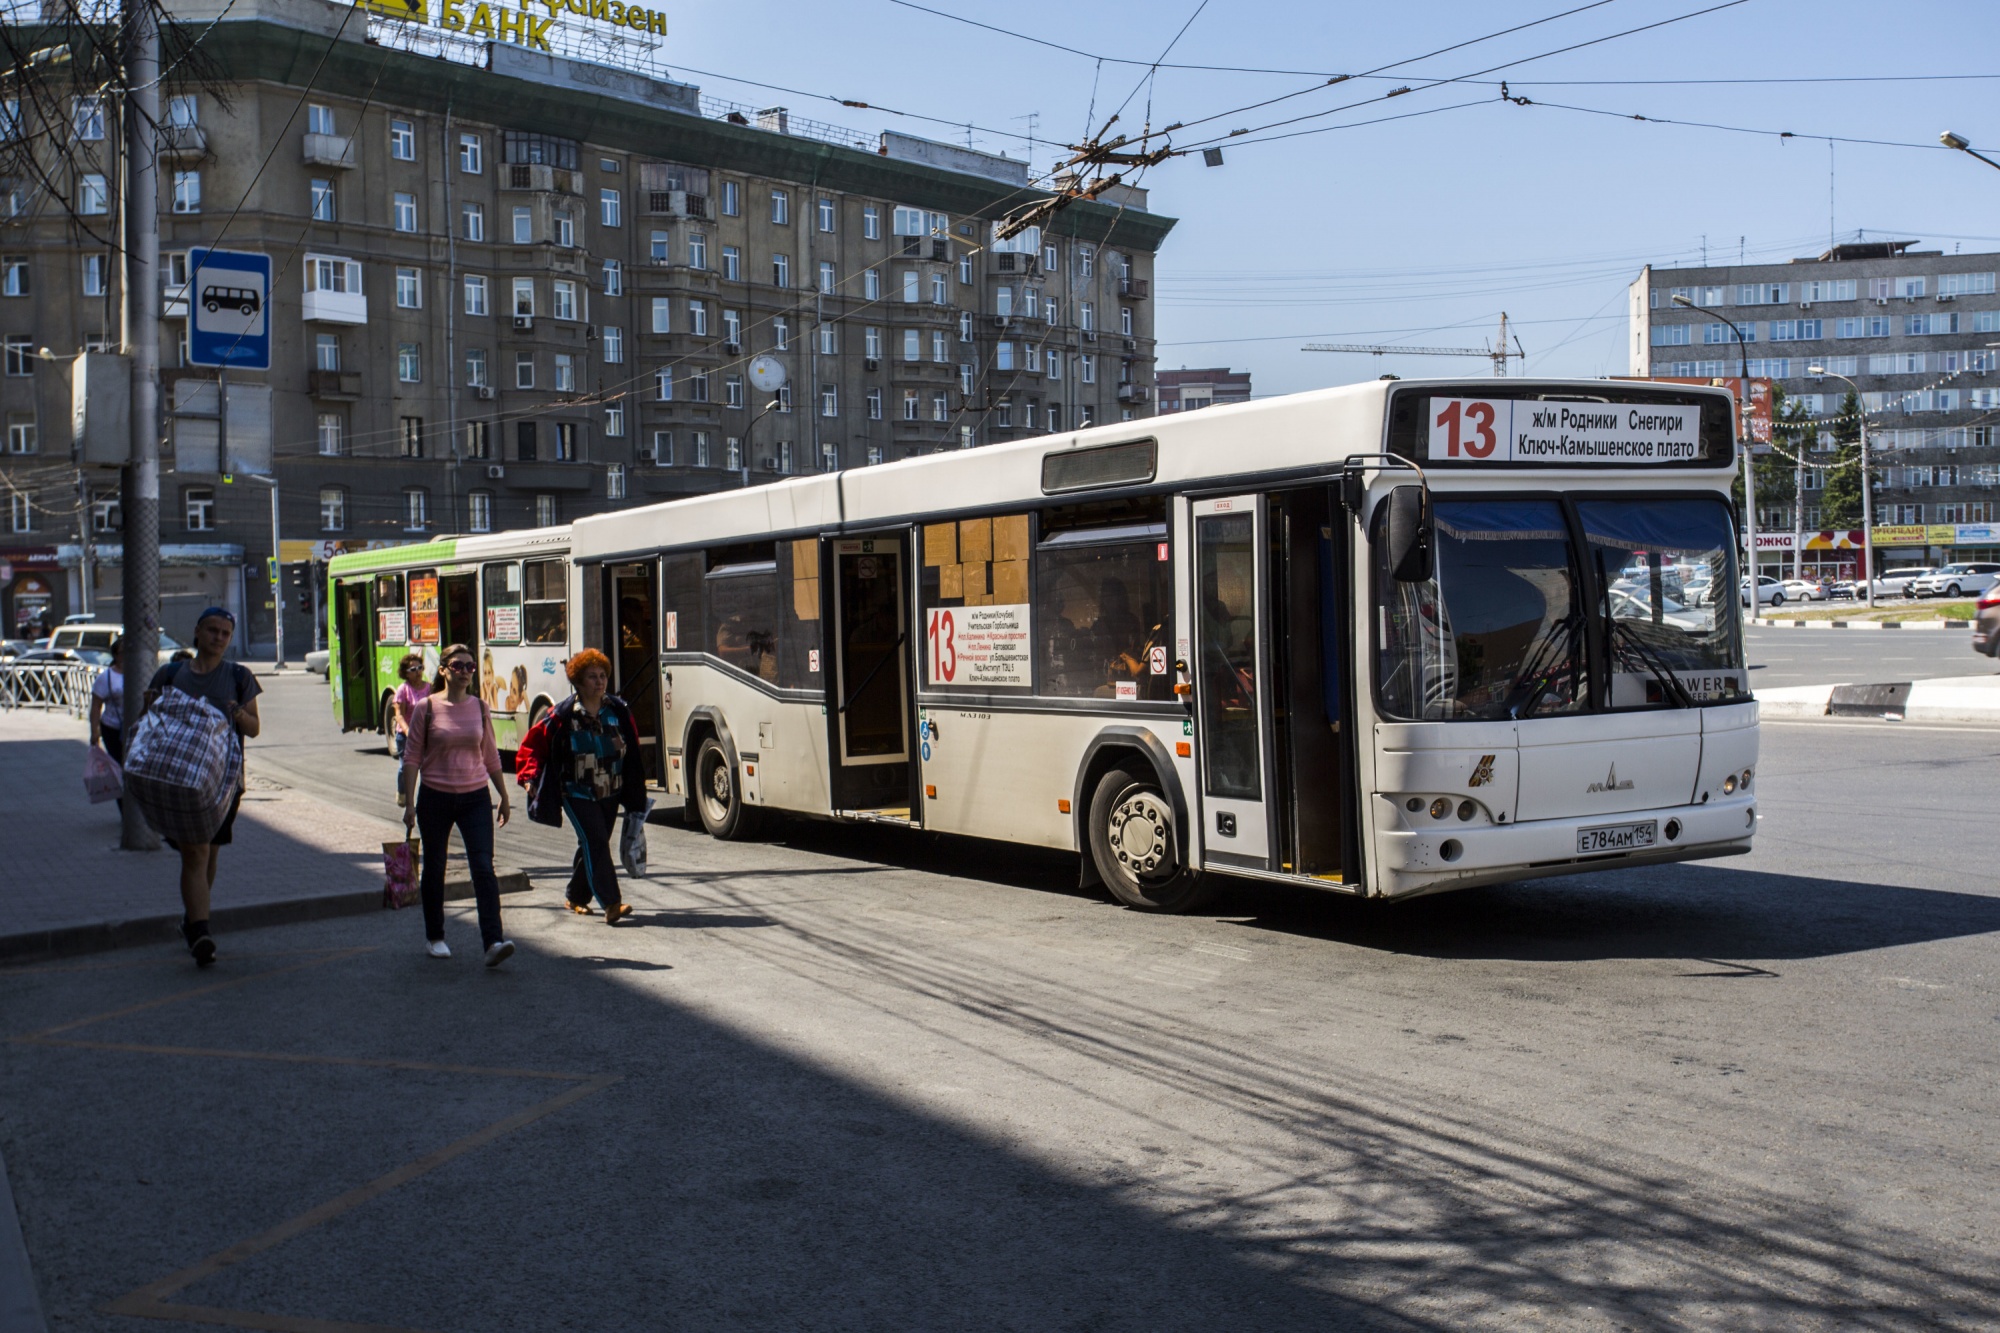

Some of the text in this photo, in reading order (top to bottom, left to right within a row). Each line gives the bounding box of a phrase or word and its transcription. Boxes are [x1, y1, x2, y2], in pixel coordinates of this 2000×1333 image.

[442, 1, 554, 51] БАНК
[1436, 401, 1497, 458] 13
[1532, 407, 1683, 436] ж/м Родники Снегири
[1518, 433, 1694, 458] Ключ-Камышенское плато
[666, 613, 677, 647] 13
[929, 610, 956, 682] 13
[1634, 826, 1652, 839] 154
